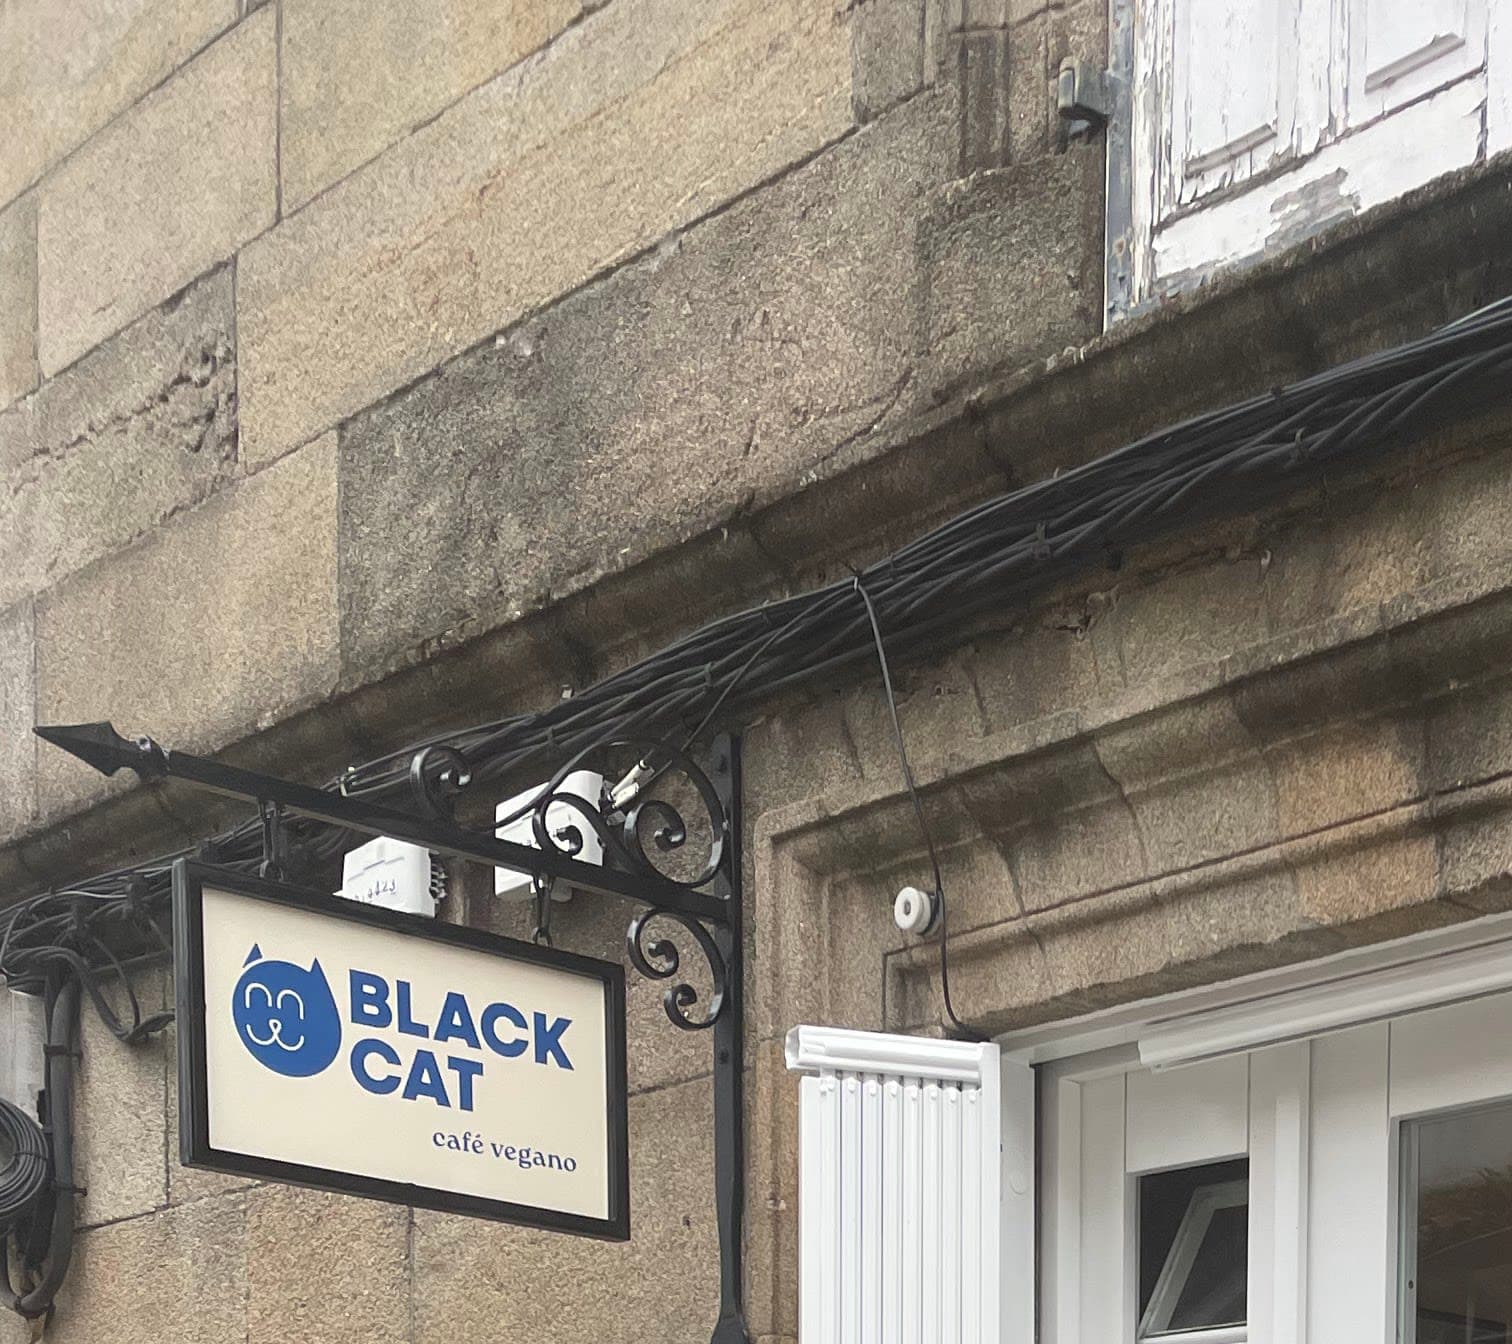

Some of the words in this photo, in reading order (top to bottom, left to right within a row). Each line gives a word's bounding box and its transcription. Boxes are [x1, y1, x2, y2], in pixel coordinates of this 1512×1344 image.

[348, 968, 575, 1071] BLACK
[349, 1037, 485, 1112] CAT
[431, 1129, 485, 1155] café
[490, 1140, 578, 1173] vegano
